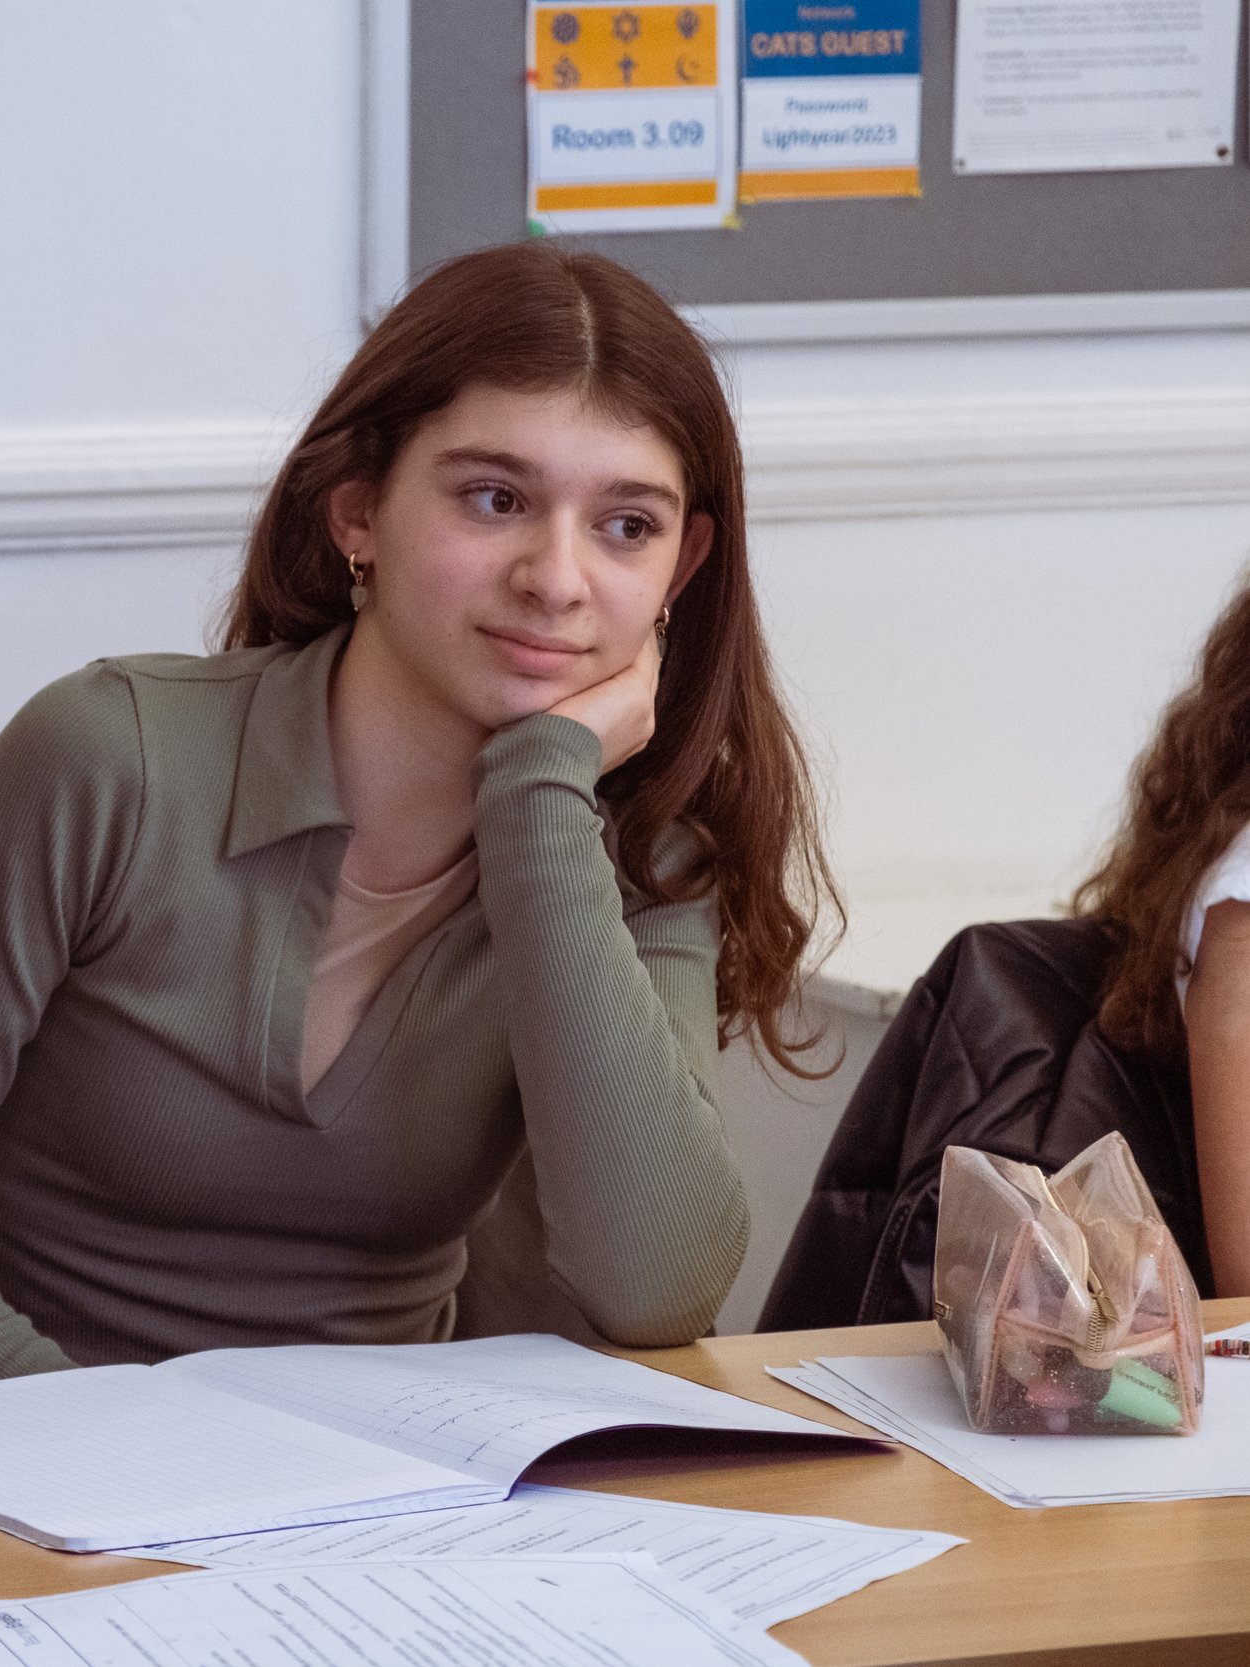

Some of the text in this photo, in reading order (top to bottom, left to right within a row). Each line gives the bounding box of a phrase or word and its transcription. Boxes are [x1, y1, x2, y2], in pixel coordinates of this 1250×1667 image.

[752, 28, 906, 59] CATS GUEST
[552, 119, 704, 150] Room 3.09
